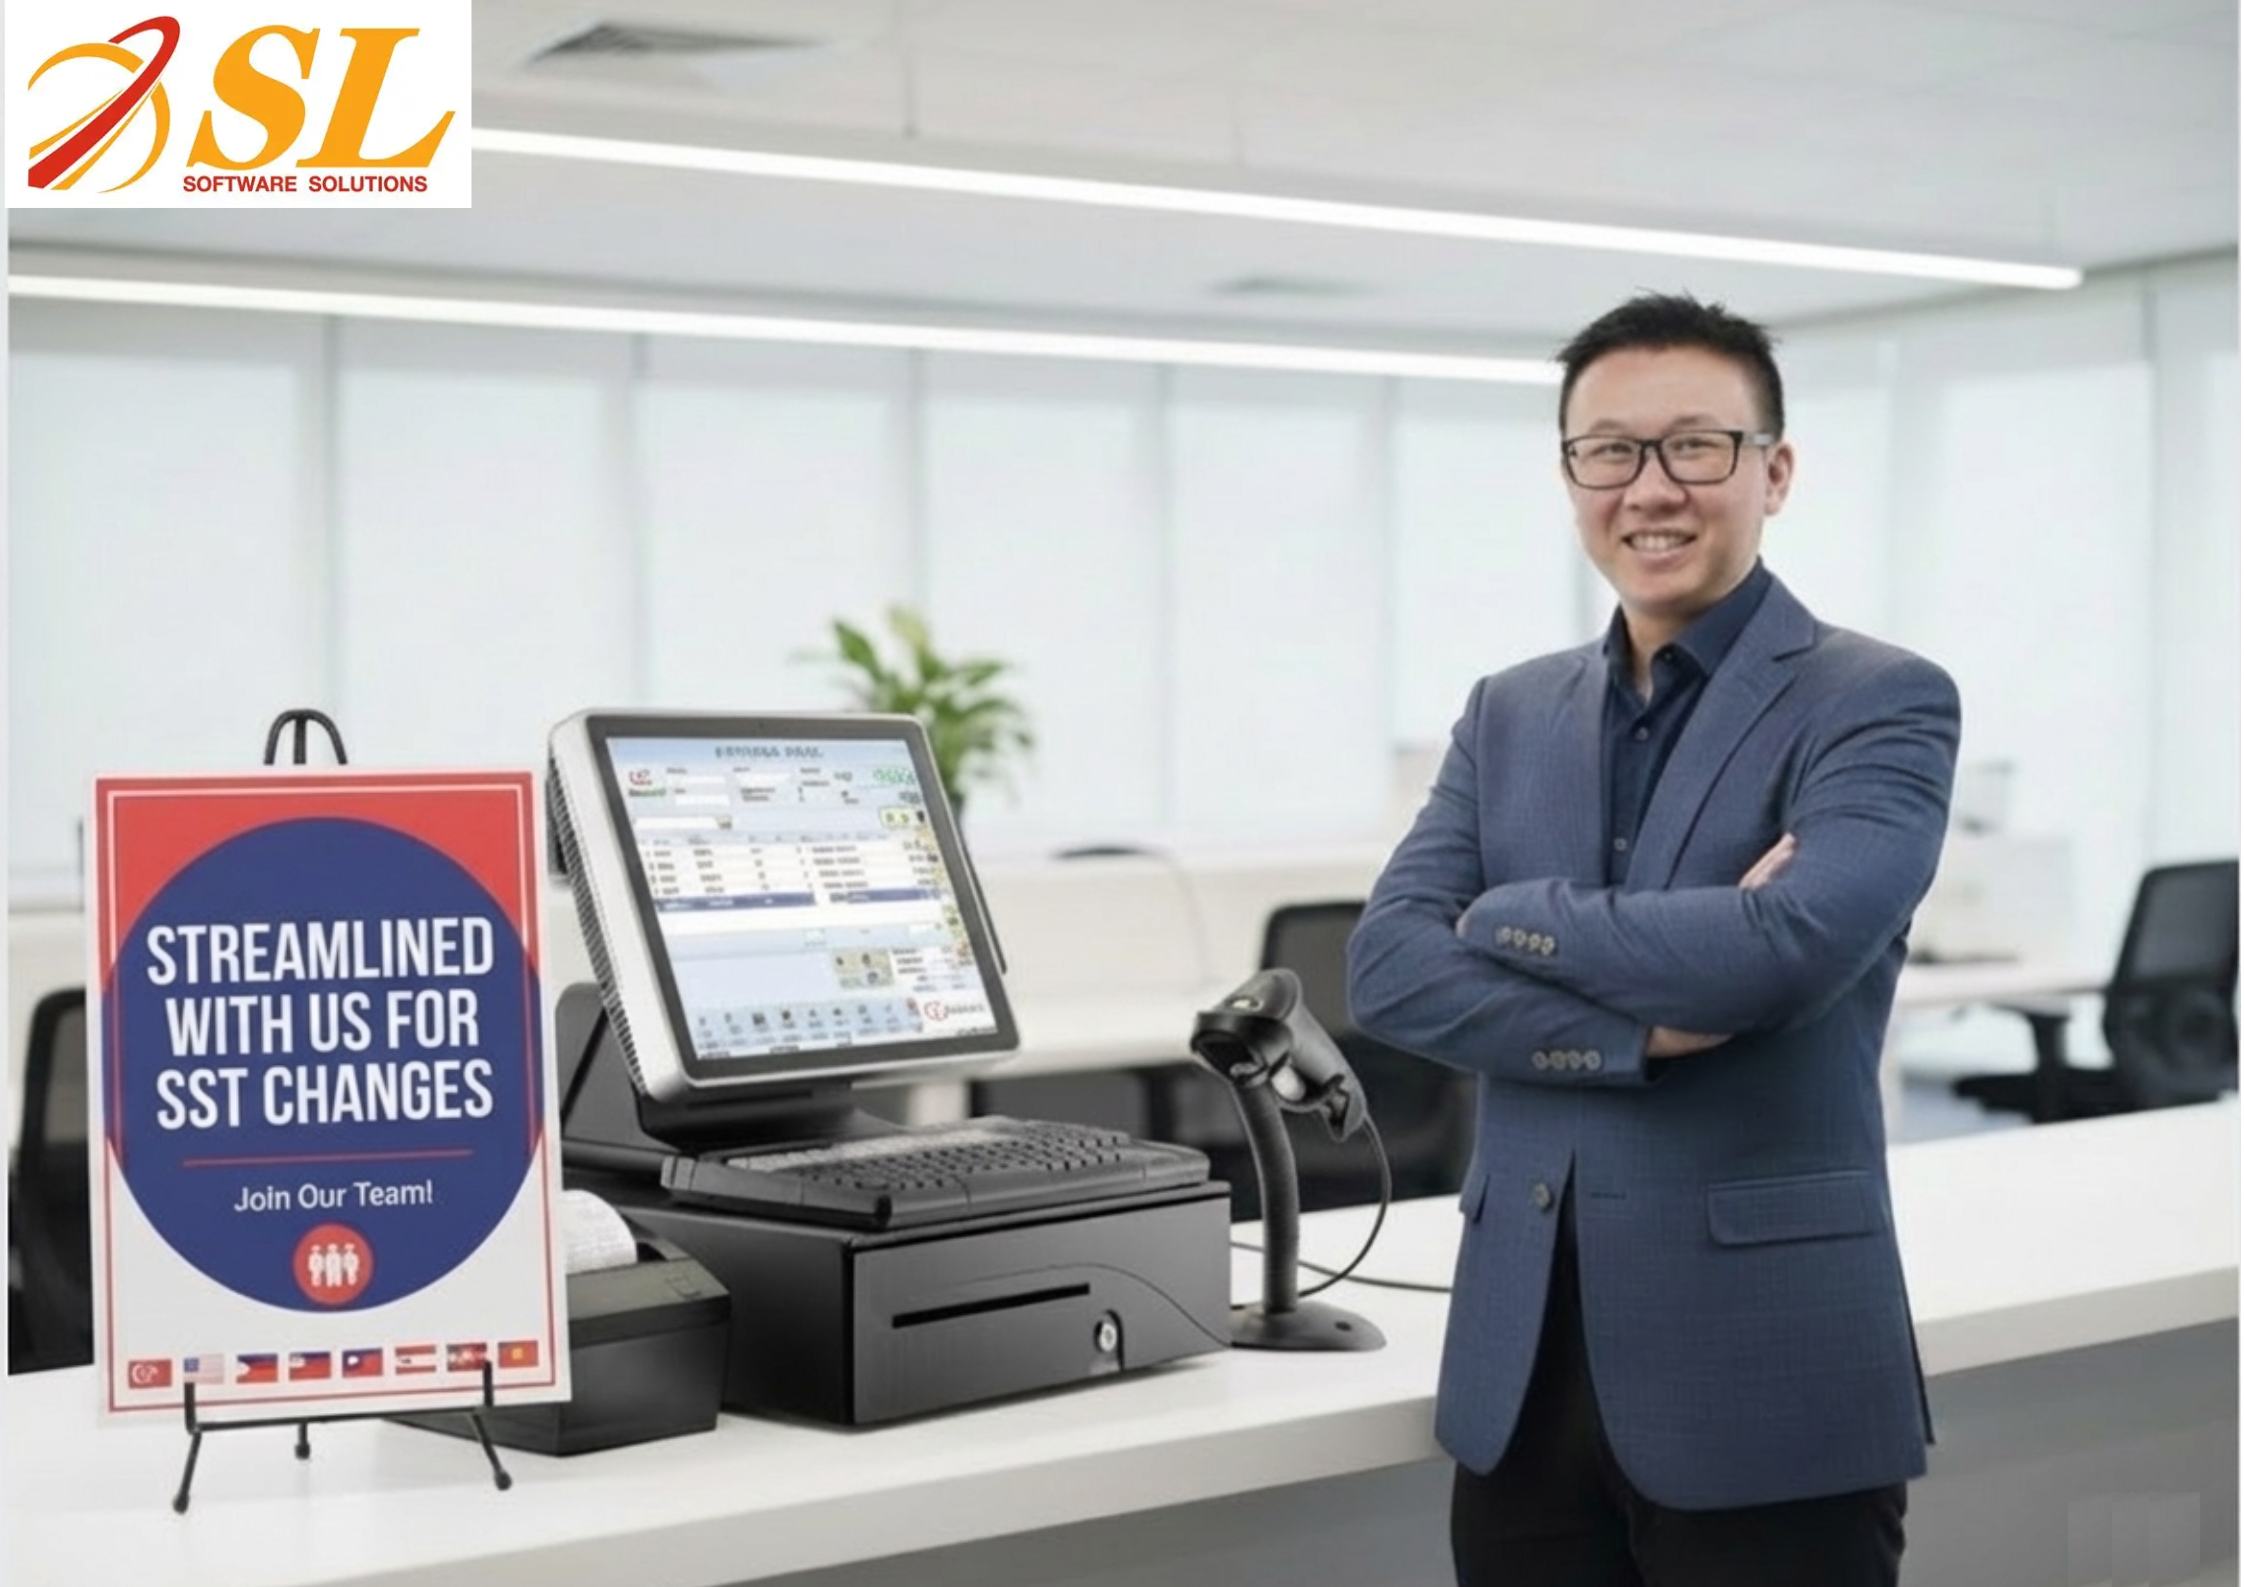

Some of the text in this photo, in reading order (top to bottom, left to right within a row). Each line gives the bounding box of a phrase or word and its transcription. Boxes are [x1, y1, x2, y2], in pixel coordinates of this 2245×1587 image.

[147, 917, 494, 985] STREAMLINED
[166, 989, 479, 1057] WITH US FOR
[156, 1059, 493, 1129] SST CHANGES
[234, 1180, 433, 1212] Join Our Team!
